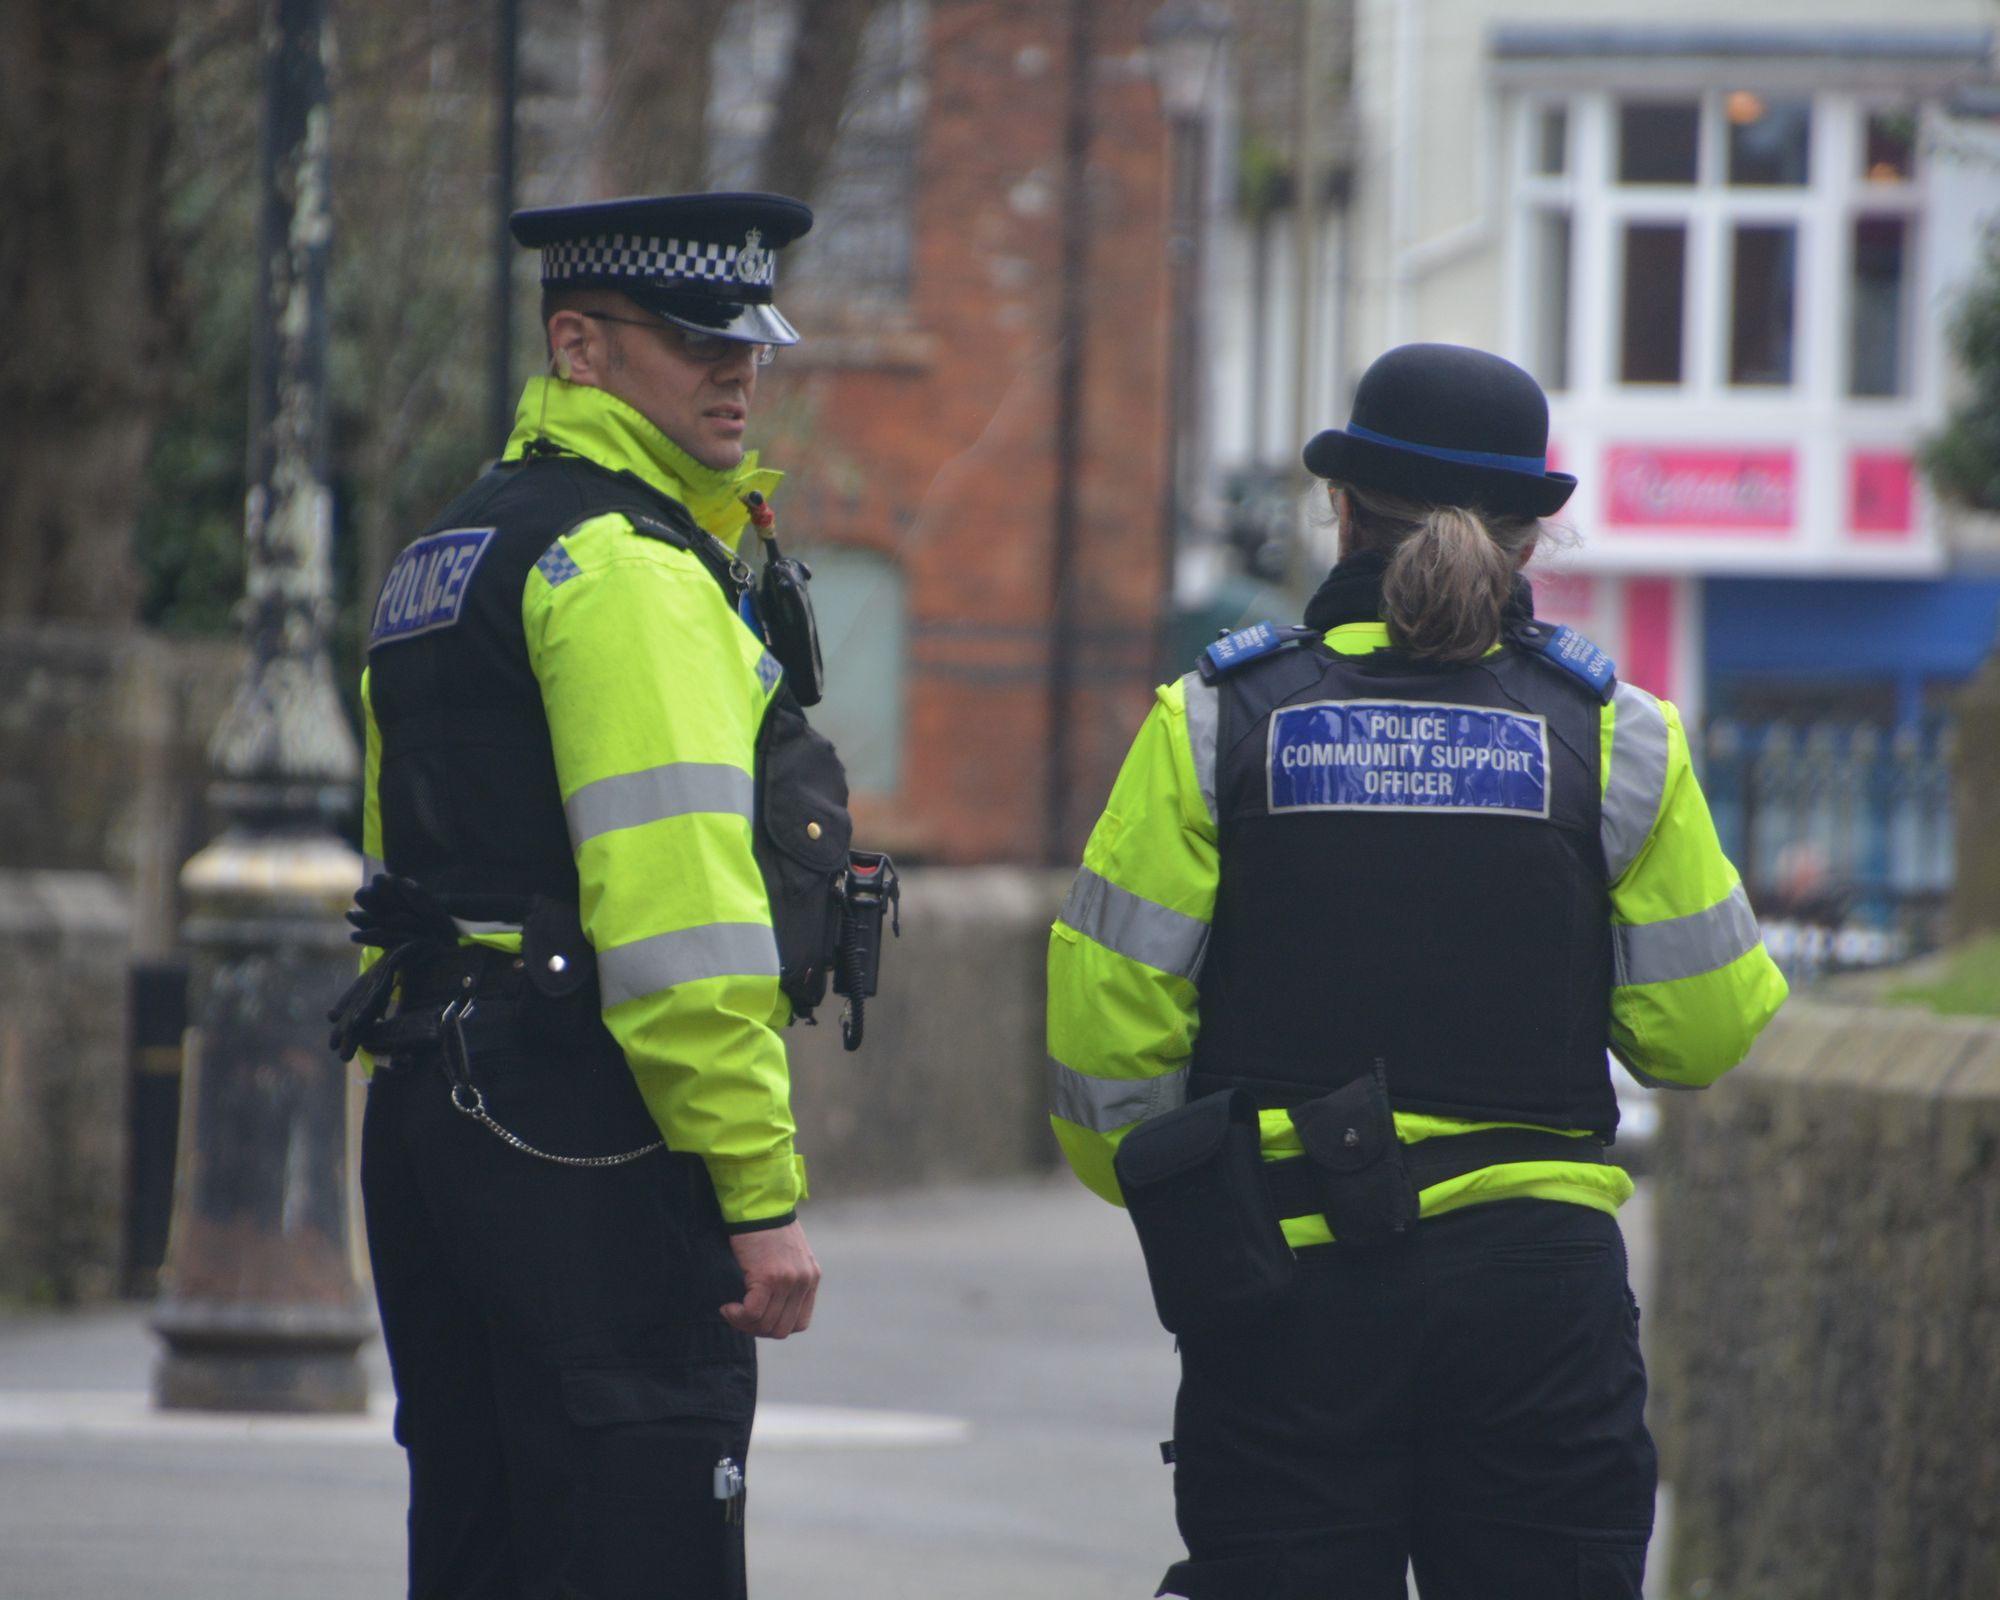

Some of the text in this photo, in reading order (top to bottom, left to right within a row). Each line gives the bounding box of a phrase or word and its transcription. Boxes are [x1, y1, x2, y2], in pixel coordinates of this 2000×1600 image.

[373, 545, 477, 634] POLICE
[1370, 716, 1446, 741] POLICE
[1282, 744, 1533, 772] COMMUNITY SUPPORT
[1364, 770, 1452, 796] OFFICER
